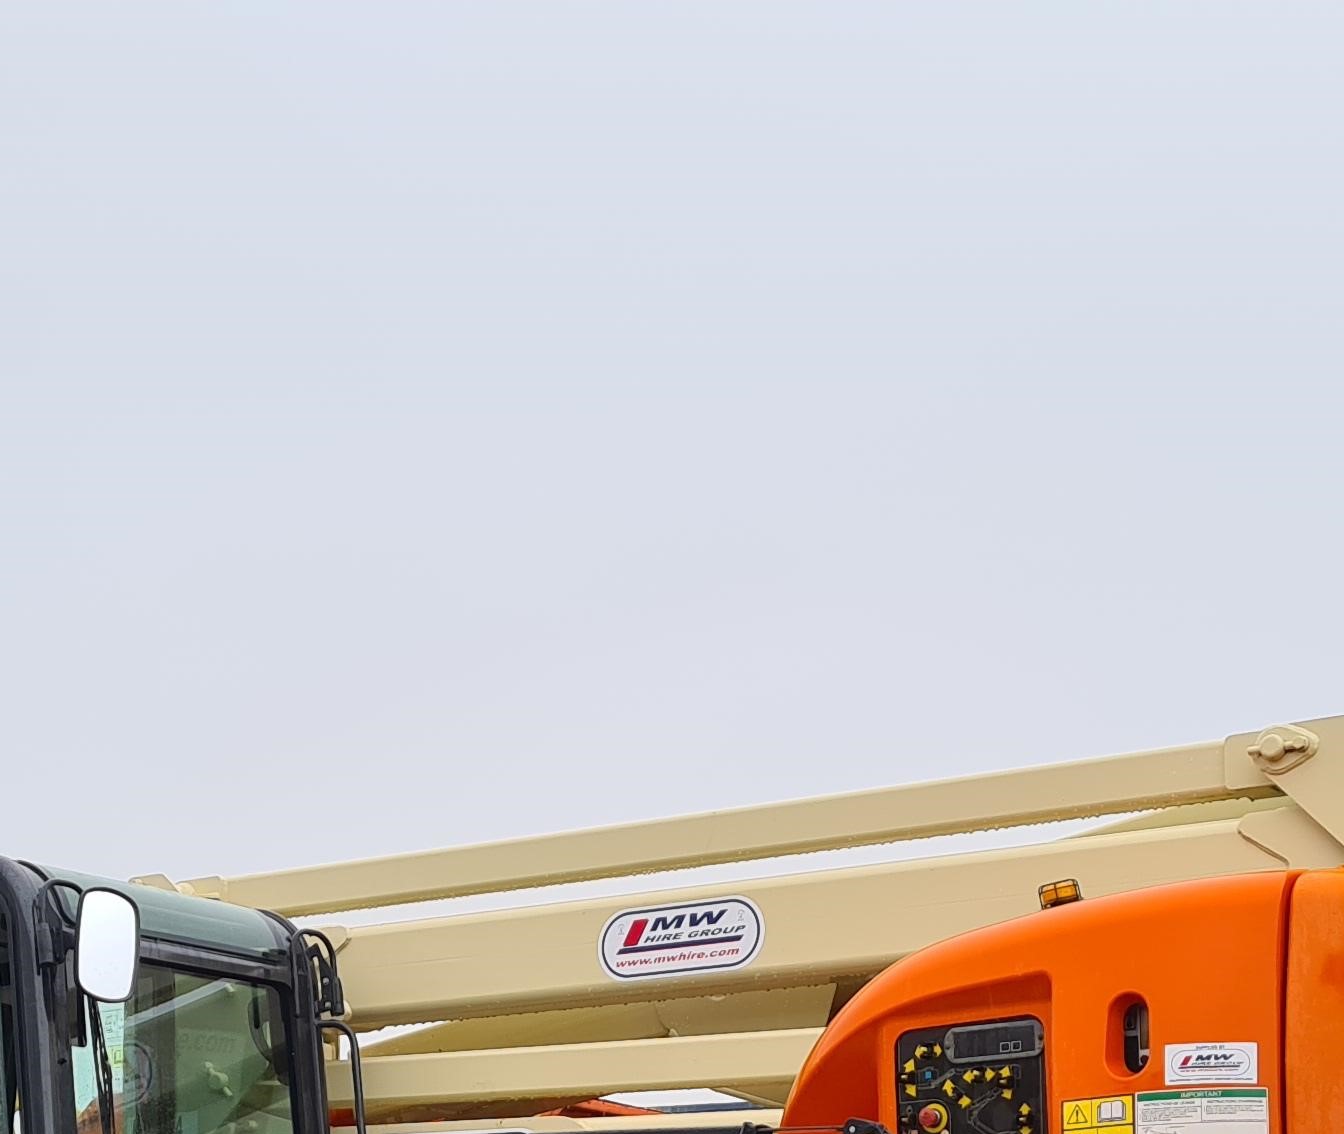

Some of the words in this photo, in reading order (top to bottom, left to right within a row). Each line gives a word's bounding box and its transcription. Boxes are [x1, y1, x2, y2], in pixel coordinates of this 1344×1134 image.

[650, 909, 729, 931] MW
[644, 932, 684, 943] HIRE
[687, 925, 747, 938] GROUP
[616, 948, 740, 968] www.mwhire.com
